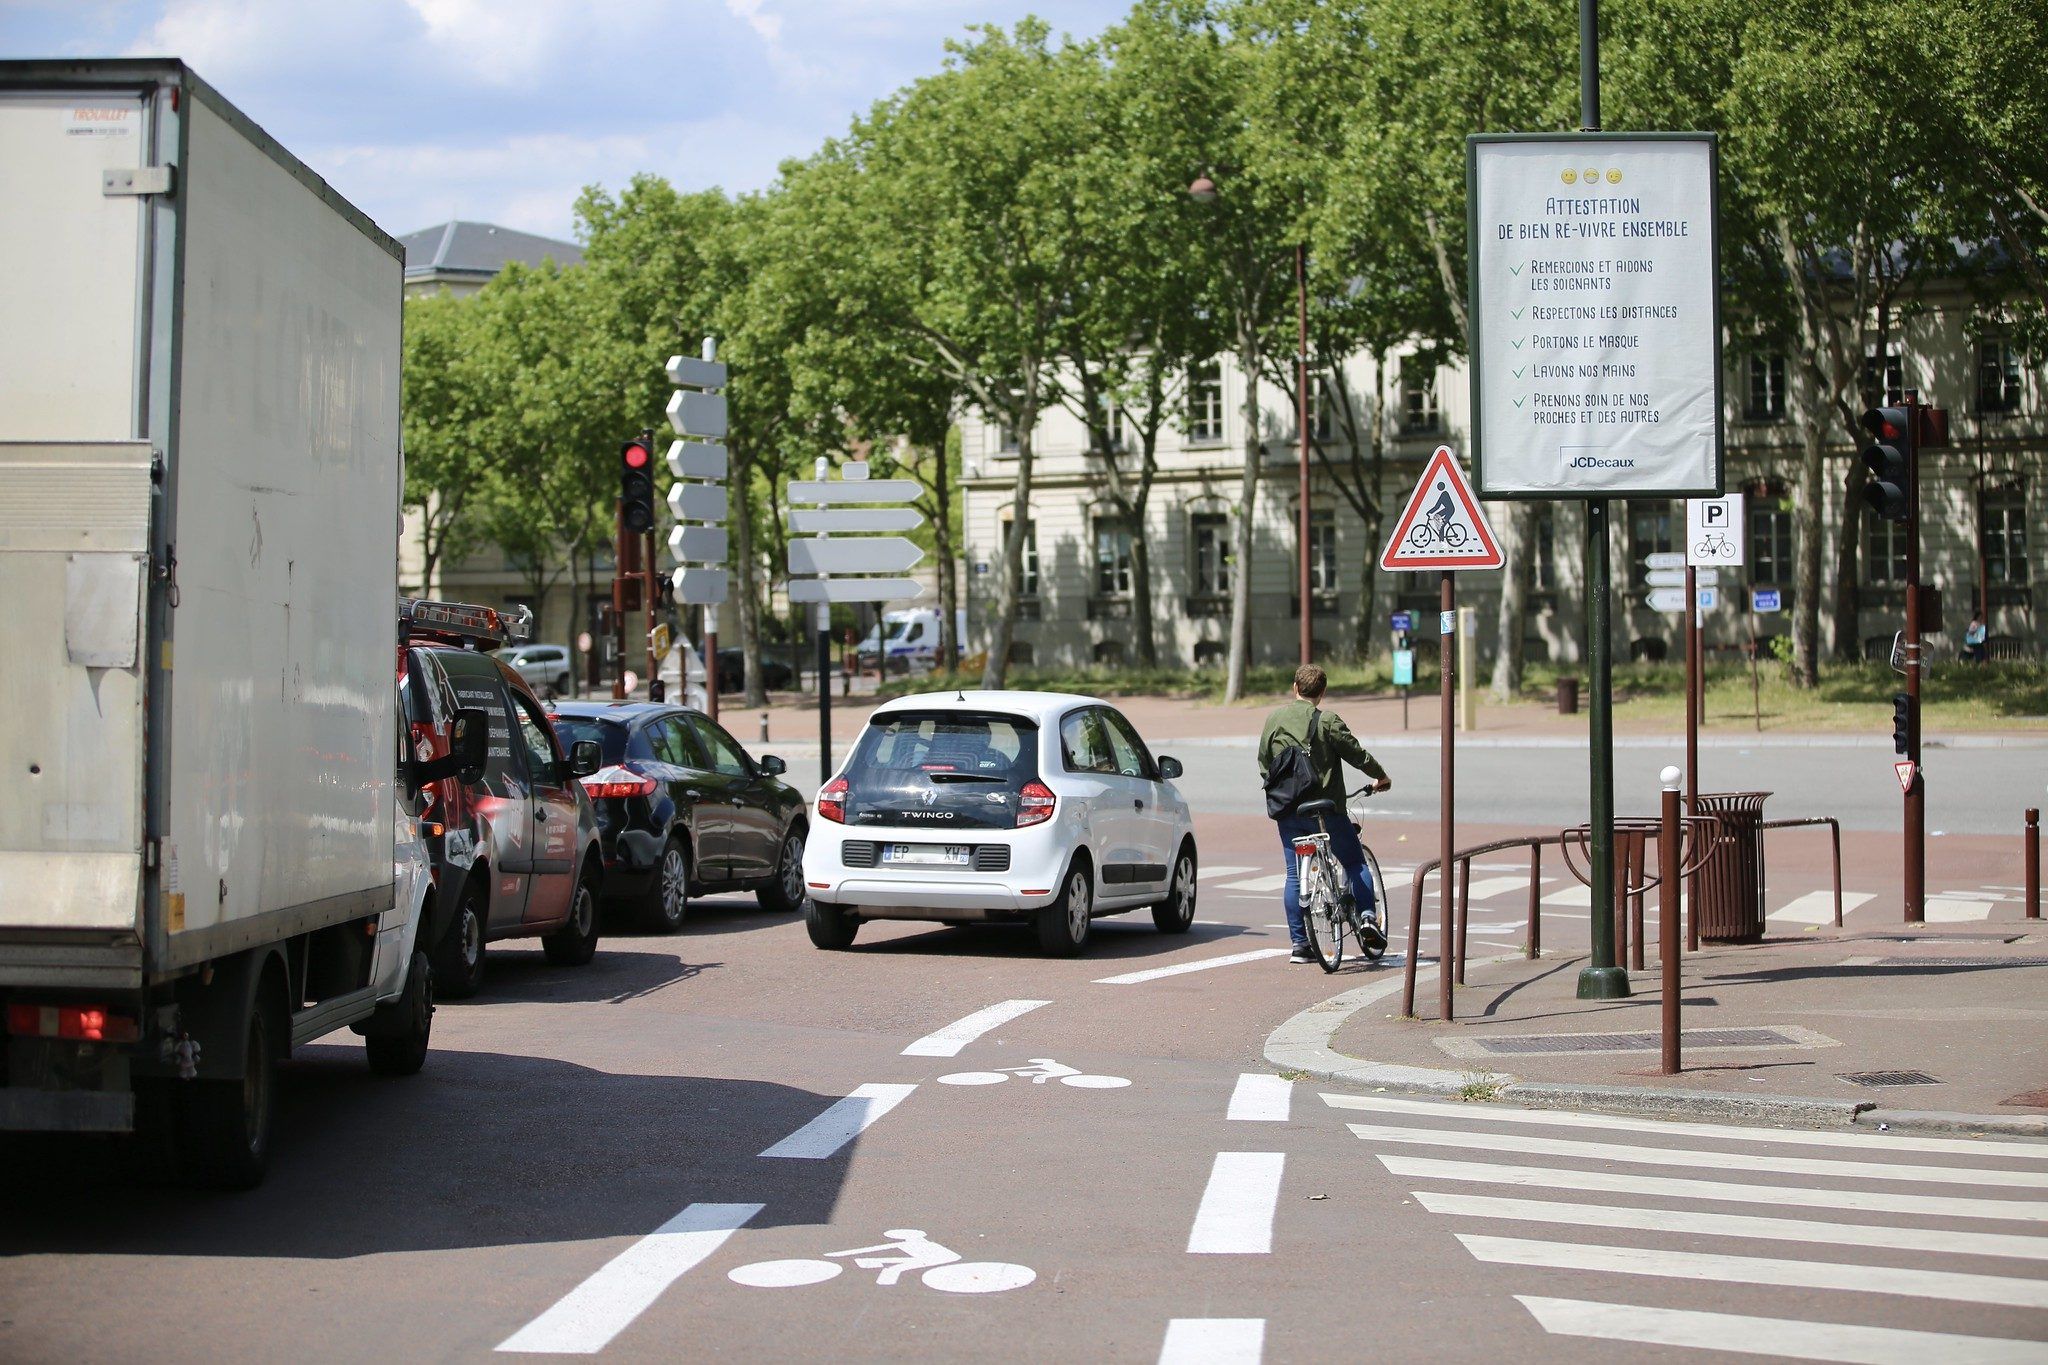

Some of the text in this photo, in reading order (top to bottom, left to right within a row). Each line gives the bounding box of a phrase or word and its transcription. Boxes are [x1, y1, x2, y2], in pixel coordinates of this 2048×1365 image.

[1546, 197, 1640, 216] ATTESTATION
[1498, 220, 1689, 240] DE BIEN RE-VIVRE ENSEMBLE
[1531, 259, 1653, 274] REMERCIONS ET AIDONS
[1531, 277, 1611, 291] LES SOIGNANTS
[1532, 304, 1678, 320] RESPECTONS LES DISTANCES
[1532, 334, 1640, 349] PORTONS LE MASQUE
[1533, 363, 1636, 378] LAVONS NOS MAINS
[1533, 392, 1649, 408] PRENONS SOIN DE NOS
[1533, 409, 1660, 425] PROCHES ET DES AUTRES
[1569, 456, 1635, 469] JCDecaux
[1708, 505, 1723, 523] P
[487, 746, 511, 757] AINTENANCE
[901, 811, 954, 819] TWINGO
[894, 845, 910, 860] EP
